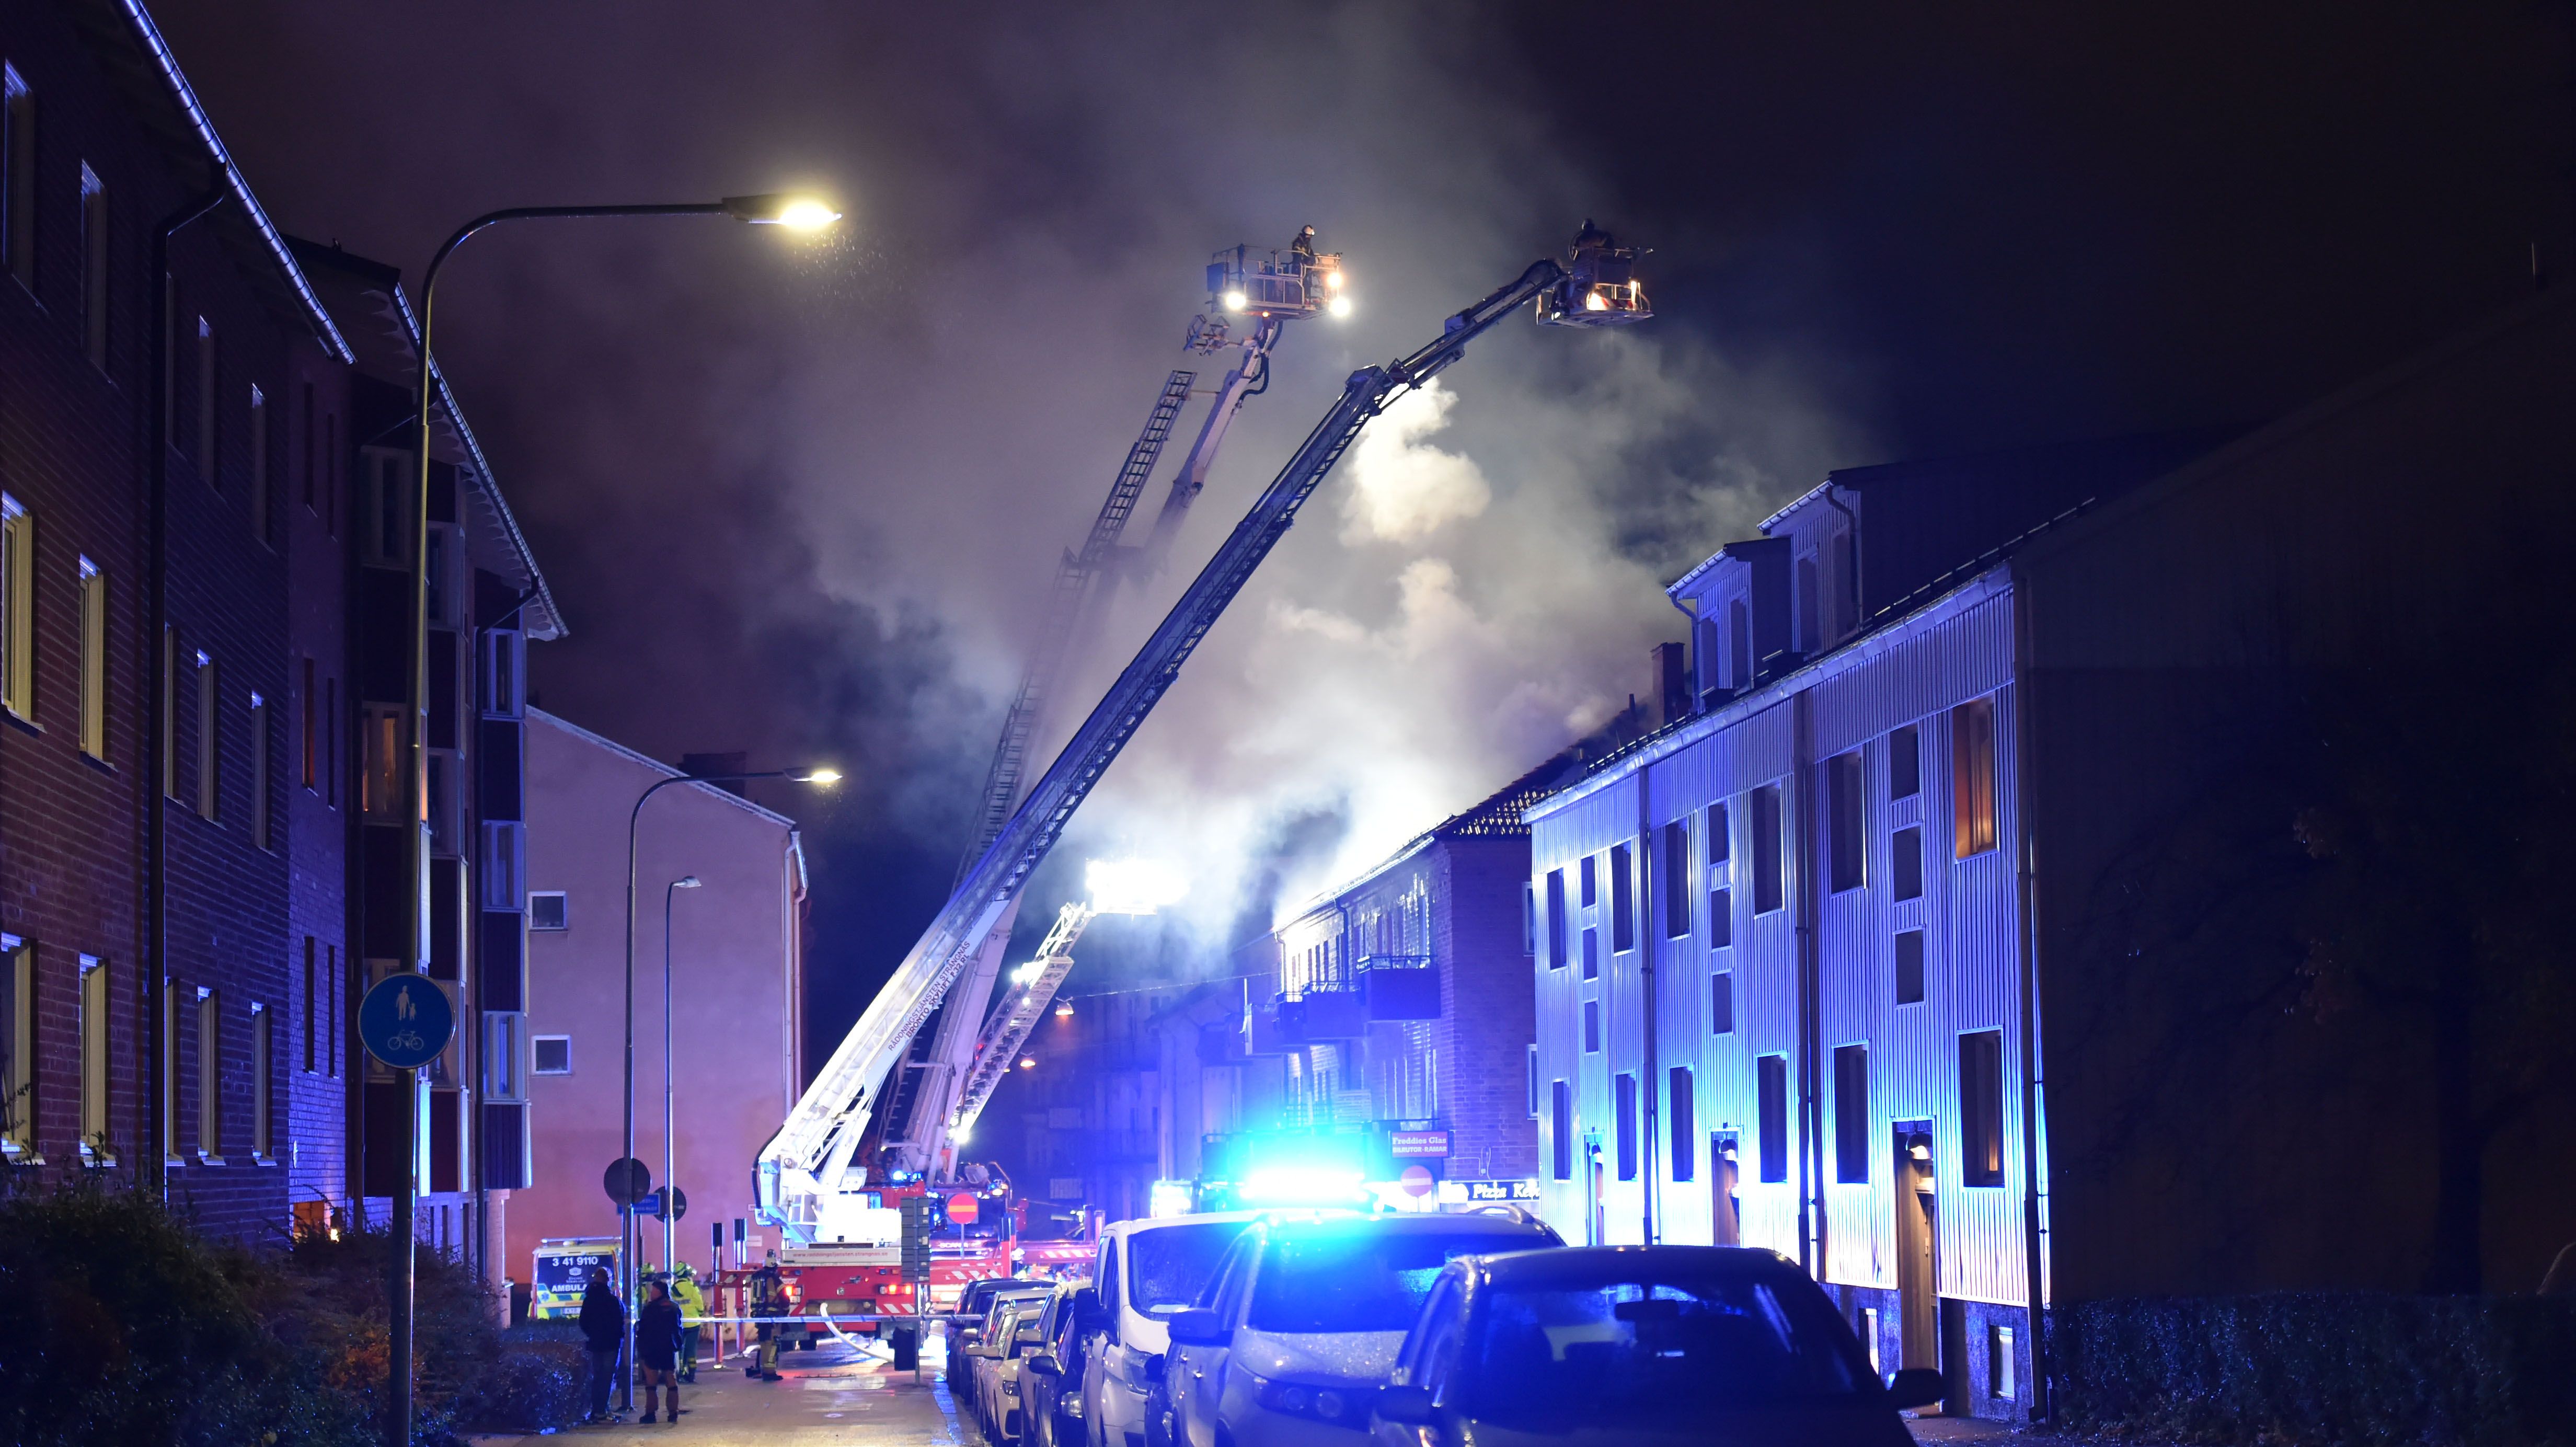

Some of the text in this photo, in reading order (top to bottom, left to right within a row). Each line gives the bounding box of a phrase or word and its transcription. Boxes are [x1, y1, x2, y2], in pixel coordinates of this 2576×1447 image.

[906, 1007, 929, 1038] BRONTO
[929, 978, 950, 1007] SKYLIFT
[1473, 1184, 1506, 1198] Pizza
[552, 1258, 559, 1267] 3
[577, 1257, 598, 1265] 9110
[551, 1284, 588, 1292] AMBULA
